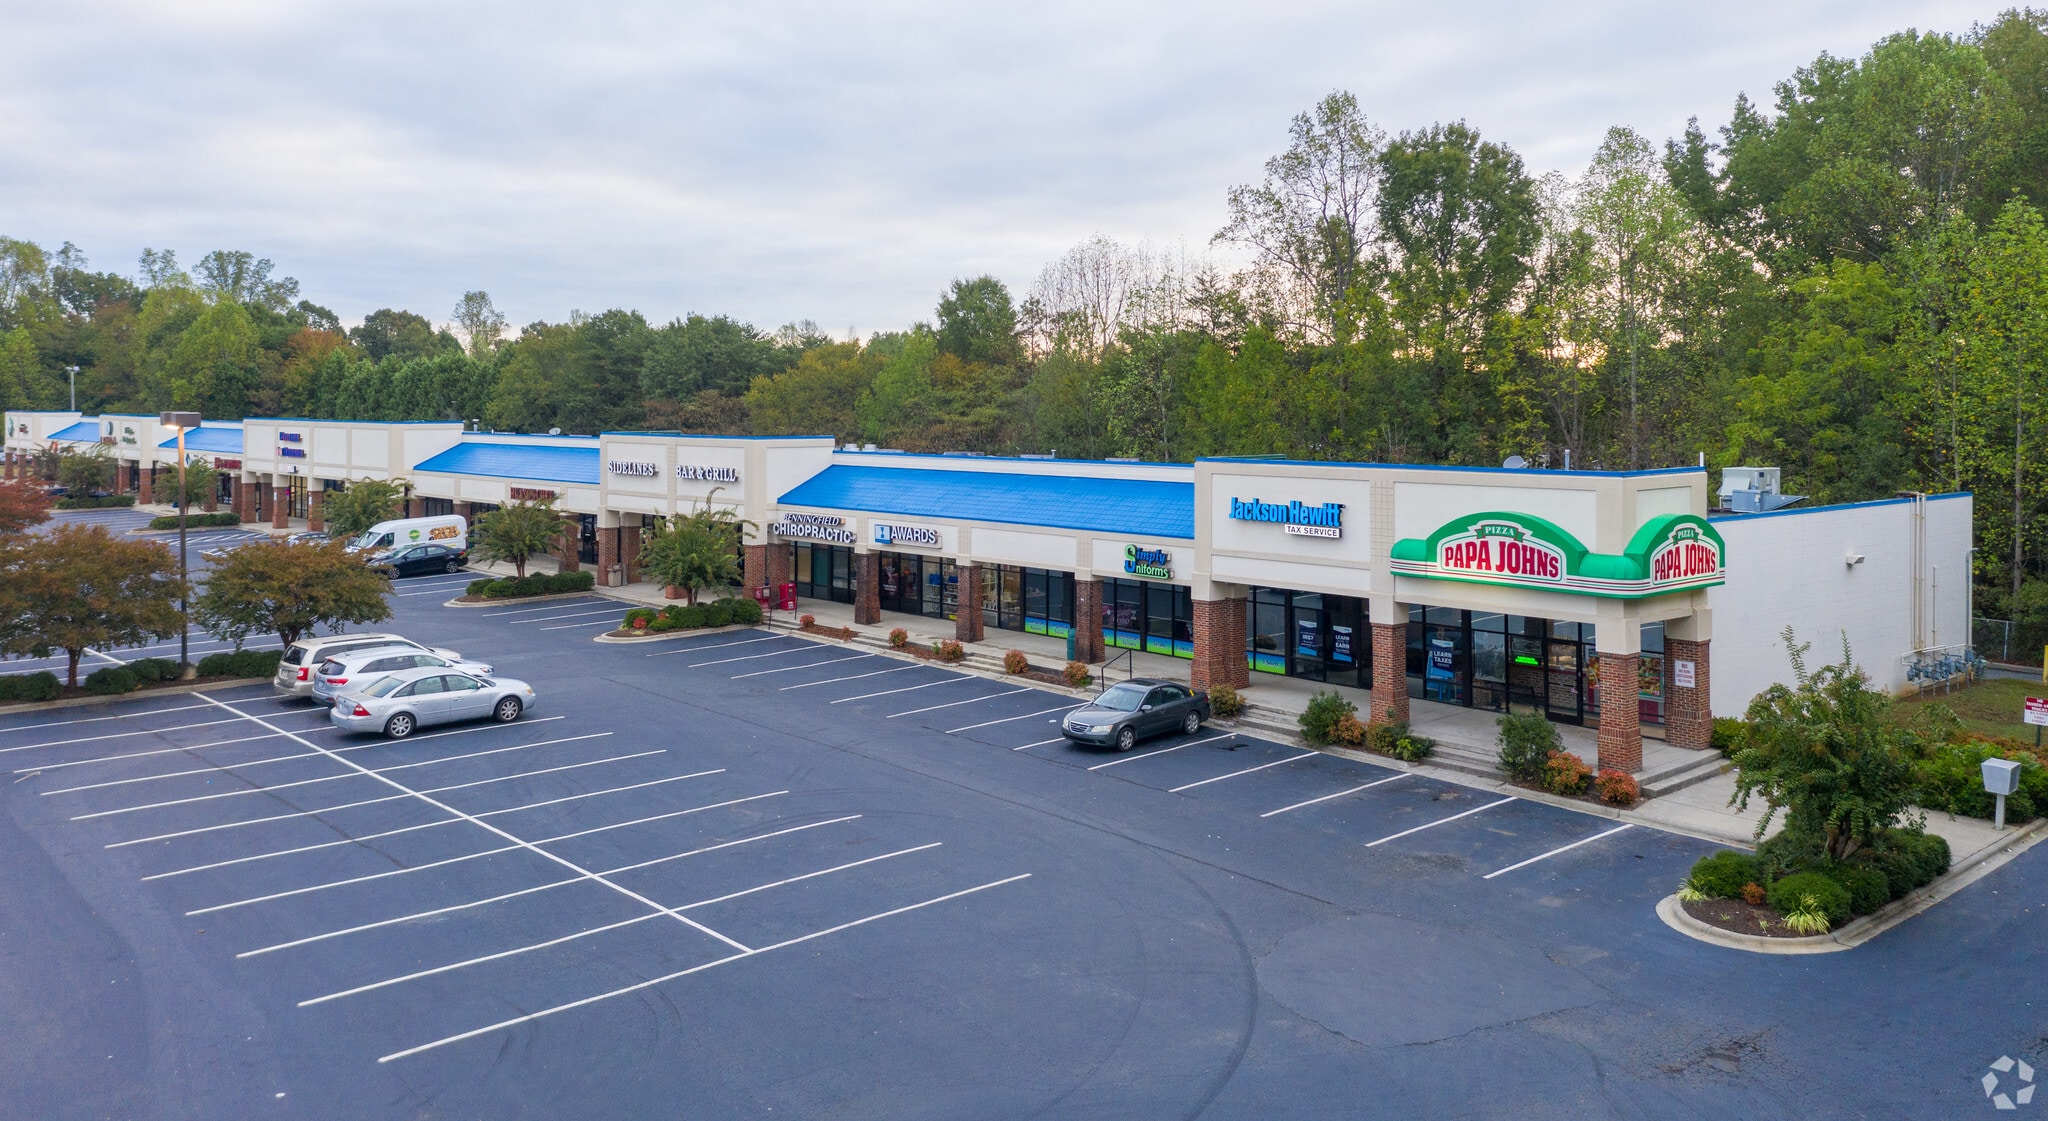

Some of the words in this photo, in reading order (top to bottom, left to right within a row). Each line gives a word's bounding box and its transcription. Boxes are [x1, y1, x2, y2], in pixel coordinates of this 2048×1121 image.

[608, 461, 655, 476] SIDELINES
[676, 465, 695, 479] BAR
[696, 466, 705, 480] &
[705, 466, 736, 482] GRILL
[783, 512, 840, 526] BENNINGFIELD
[1229, 497, 1288, 523] Jackson
[1289, 500, 1341, 528] Hewitt
[772, 522, 852, 544] CHIROPRACTIC
[890, 525, 936, 544] AWARDS
[1286, 525, 1302, 535] TAX
[1303, 527, 1338, 537] SERVICE
[1484, 525, 1515, 537] PIZZA
[1677, 528, 1695, 539] PIZZA
[1444, 540, 1492, 571] PAPA
[1654, 546, 1682, 581] PAPA
[1433, 650, 1452, 659] LEARN
